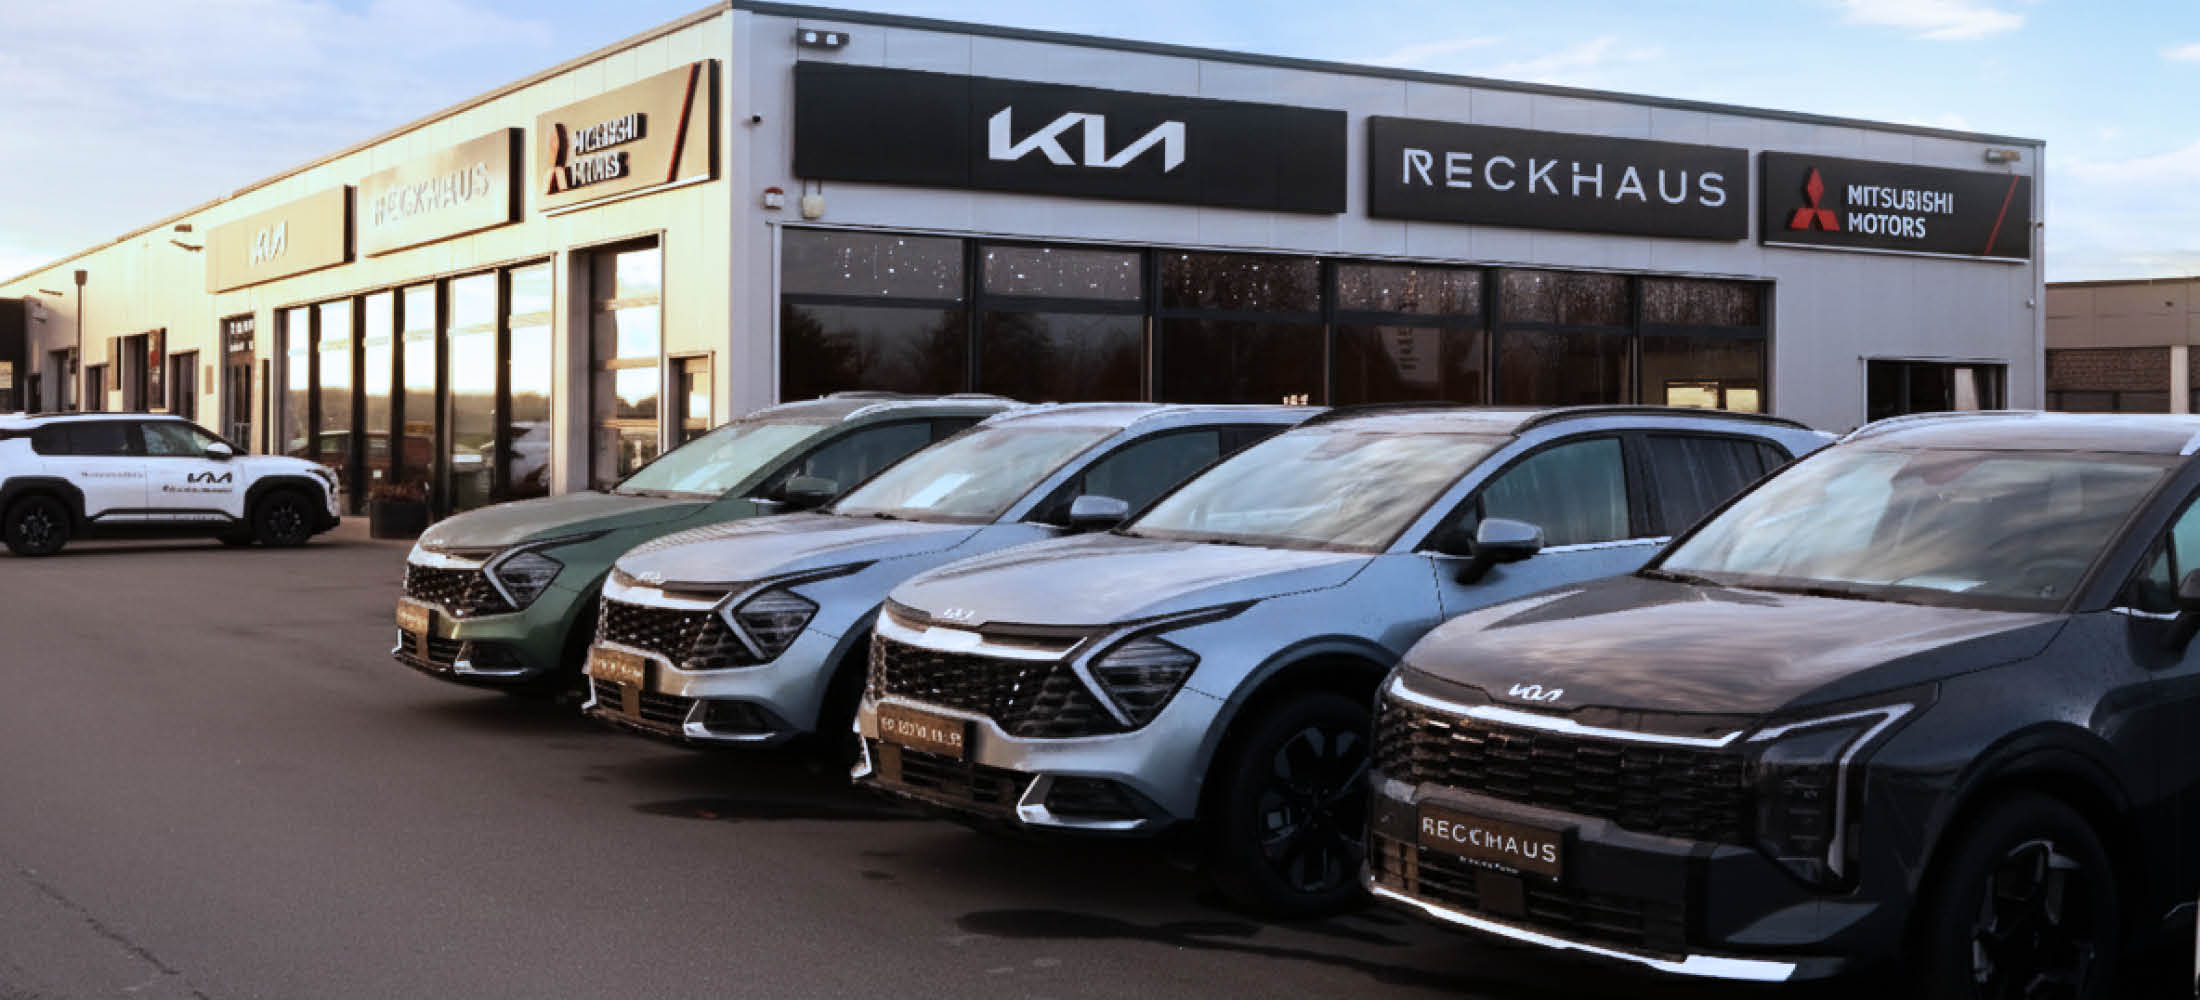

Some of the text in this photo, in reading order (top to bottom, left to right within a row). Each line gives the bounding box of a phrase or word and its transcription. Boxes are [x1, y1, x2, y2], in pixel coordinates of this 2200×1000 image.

[988, 105, 1186, 174] KIA
[1402, 148, 1728, 207] RECKHAUS
[1847, 184, 1954, 215] MITSUBISHI
[1847, 212, 1927, 239] MOTORS
